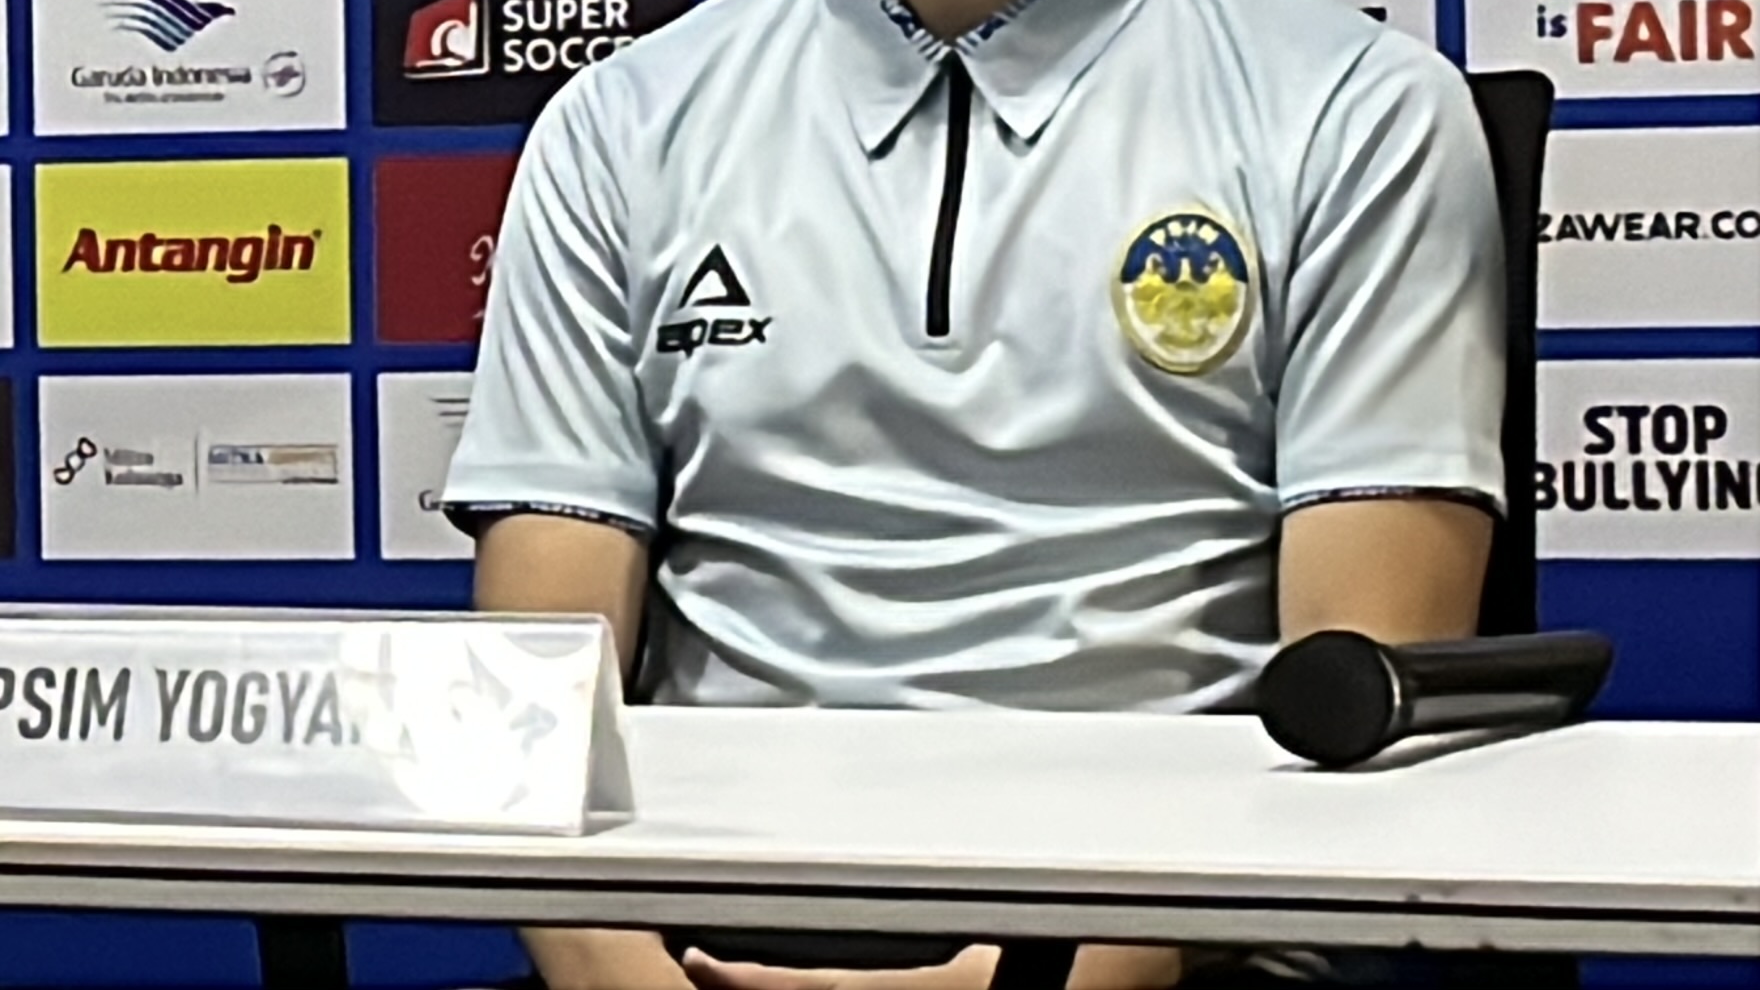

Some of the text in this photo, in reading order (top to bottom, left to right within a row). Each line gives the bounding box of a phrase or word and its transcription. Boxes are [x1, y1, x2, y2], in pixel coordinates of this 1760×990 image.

[1536, 4, 1568, 38] is
[502, 36, 636, 73] SOCC
[62, 225, 316, 283] Antangin
[1583, 405, 1729, 456] STOP
[1534, 460, 1760, 512] BULLYIN
[155, 669, 361, 747] YOGYA
